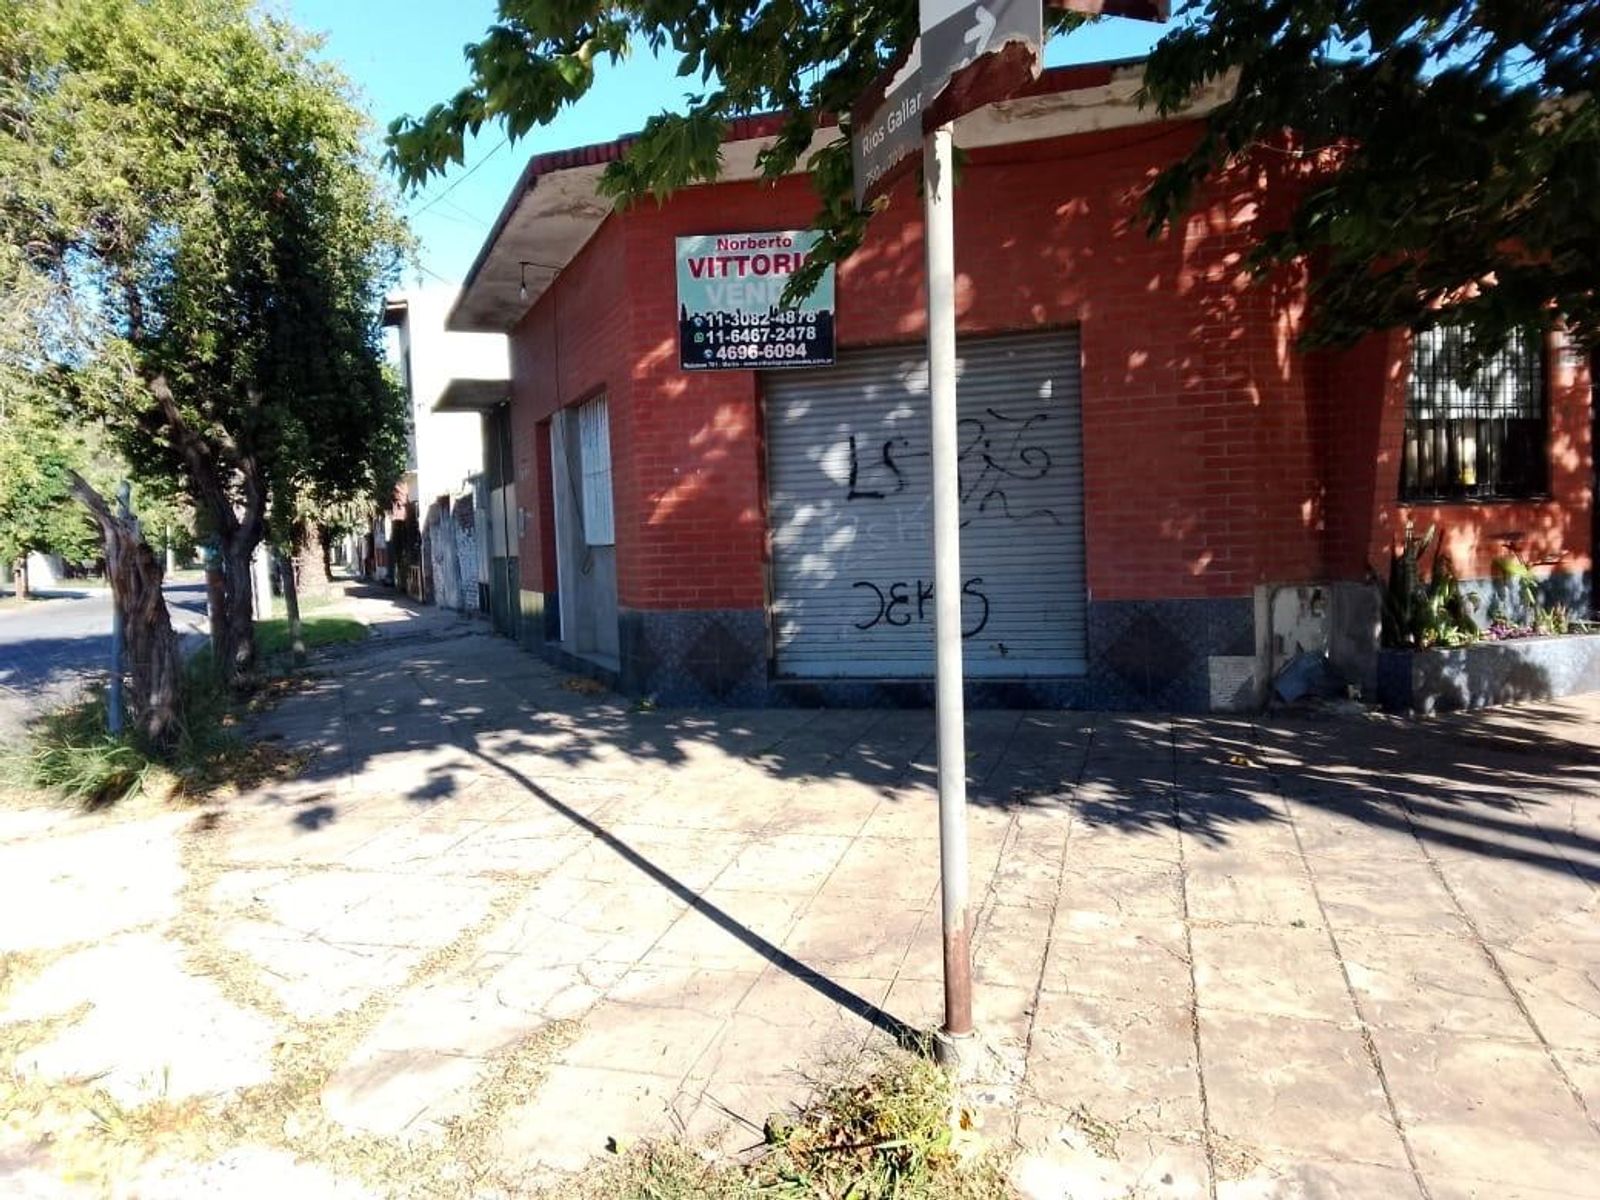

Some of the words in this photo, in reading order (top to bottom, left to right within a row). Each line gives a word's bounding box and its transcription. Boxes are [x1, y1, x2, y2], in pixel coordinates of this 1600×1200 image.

[717, 236, 792, 251] Norberto
[687, 252, 806, 279] VITTORI
[706, 327, 816, 344] 11-6467-2478
[716, 344, 807, 360] 4696-6094
